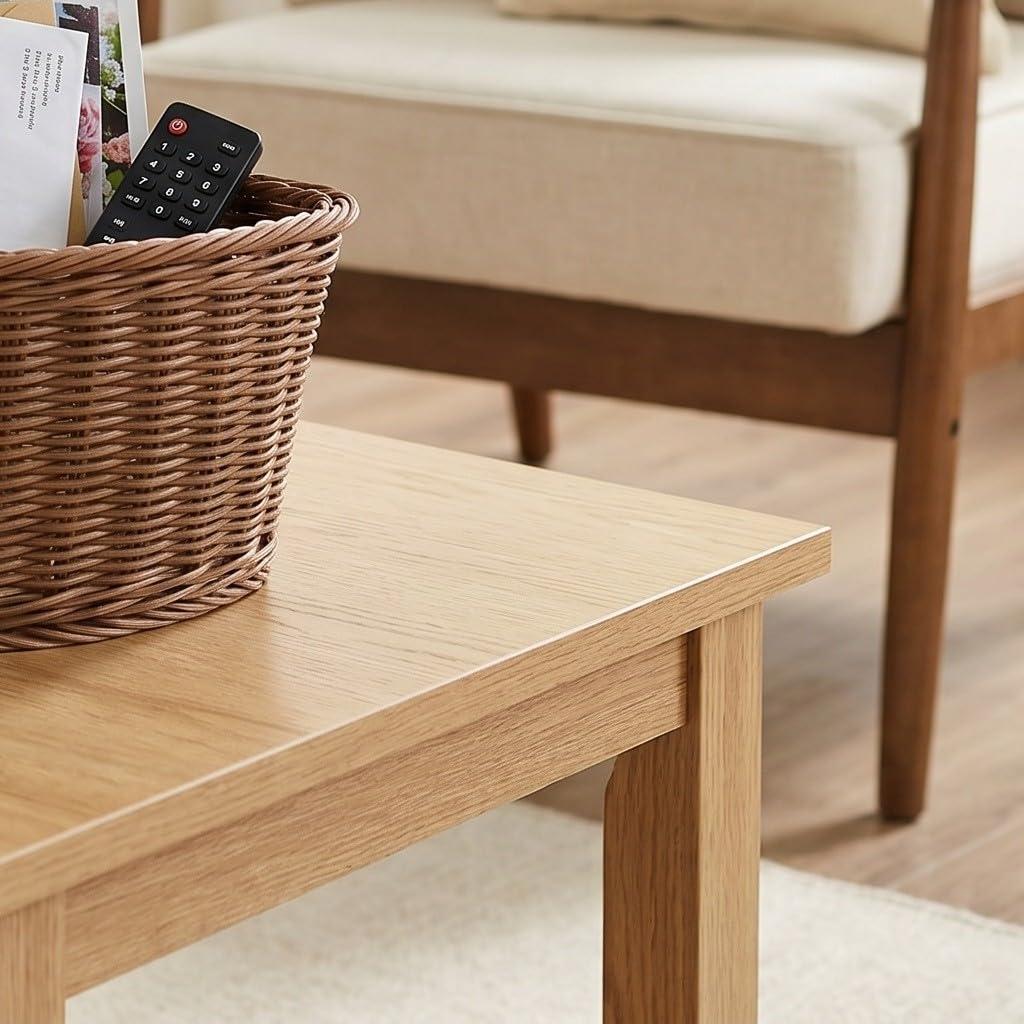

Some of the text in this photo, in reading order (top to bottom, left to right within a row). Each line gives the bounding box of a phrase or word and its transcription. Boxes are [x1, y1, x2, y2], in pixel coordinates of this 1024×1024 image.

[161, 142, 168, 151] 1
[185, 152, 195, 161] 2
[149, 160, 158, 168] 4
[139, 176, 149, 185] 7
[155, 205, 164, 215] 0
